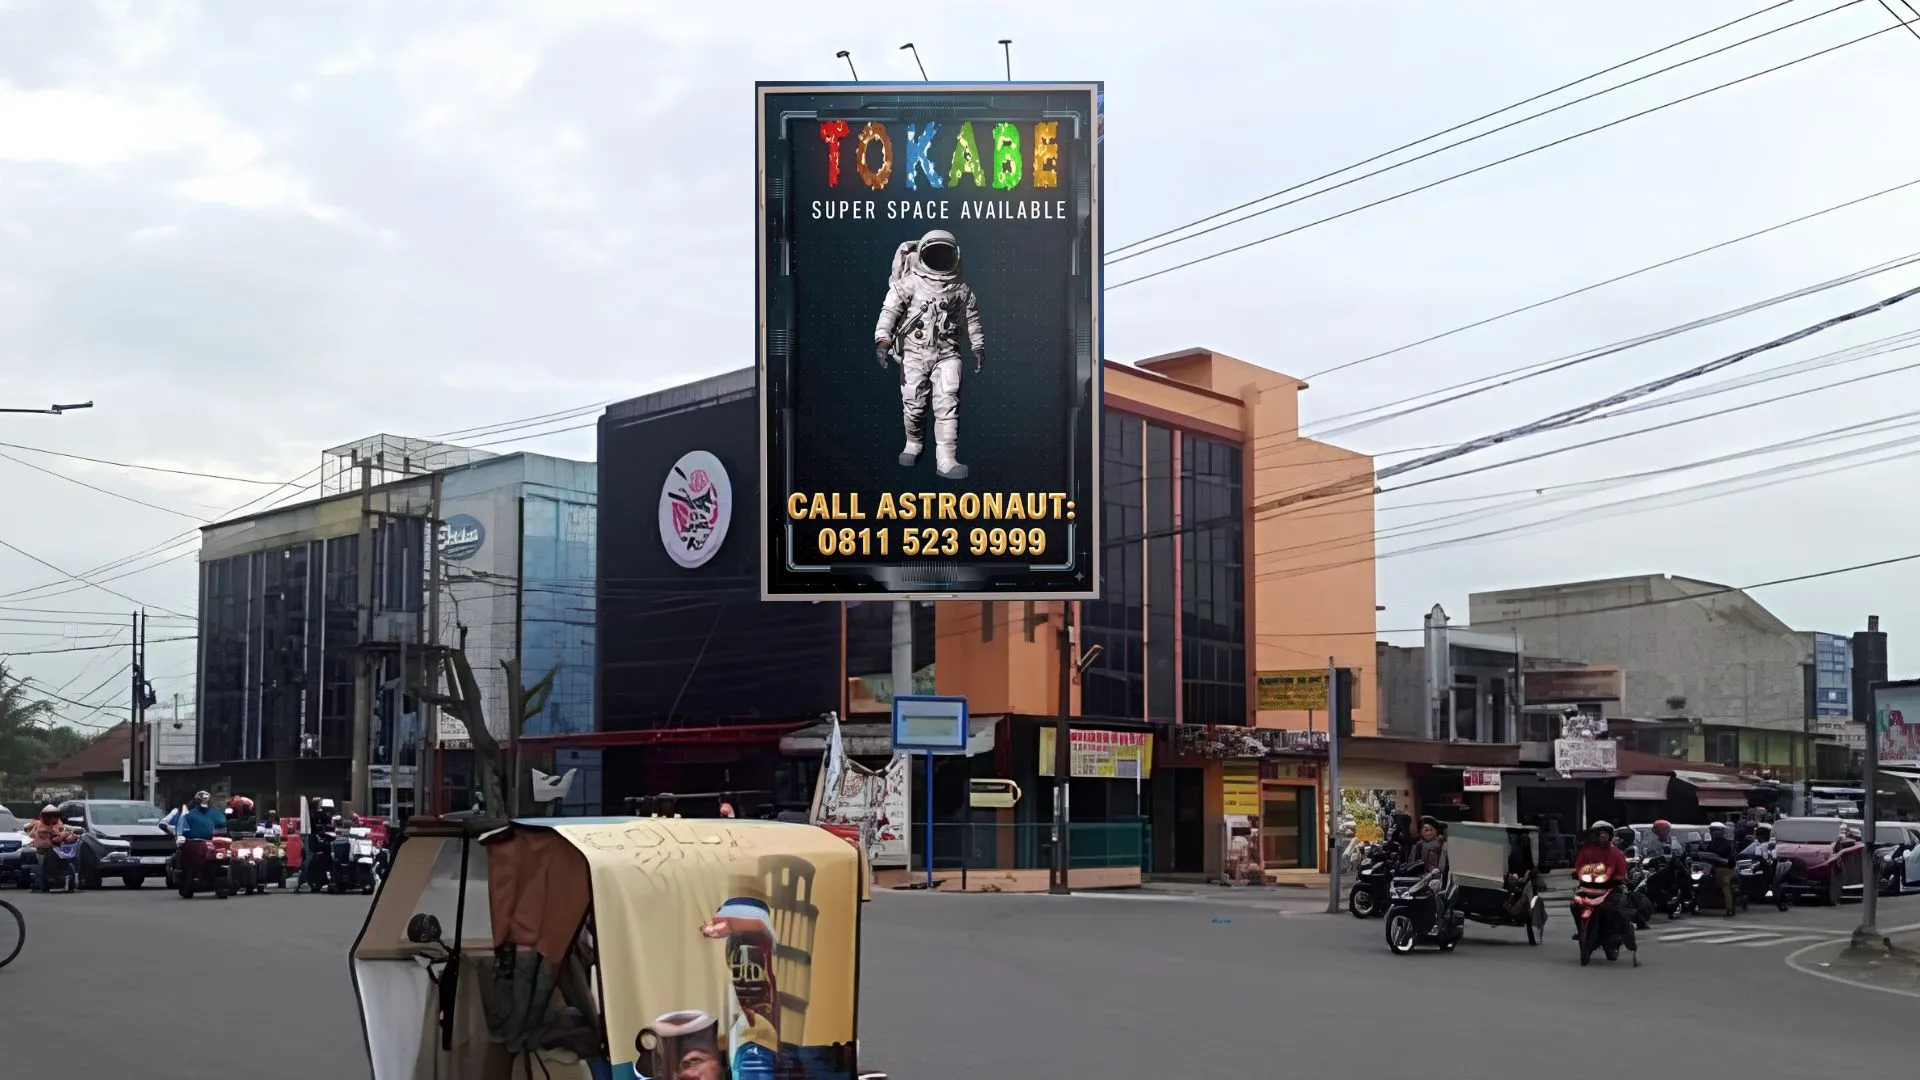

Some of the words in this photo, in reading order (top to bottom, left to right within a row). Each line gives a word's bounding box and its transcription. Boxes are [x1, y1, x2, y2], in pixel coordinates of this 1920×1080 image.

[819, 120, 1059, 190] TOKABE
[811, 200, 876, 220] SUPER
[887, 200, 949, 220] SPACE
[960, 200, 1066, 220] AVAILABLE
[787, 492, 866, 520] CALL
[876, 492, 1076, 520] ASTRONAUT:
[818, 527, 889, 556] 0811
[902, 527, 959, 556] 523
[969, 527, 1046, 556] 9999
